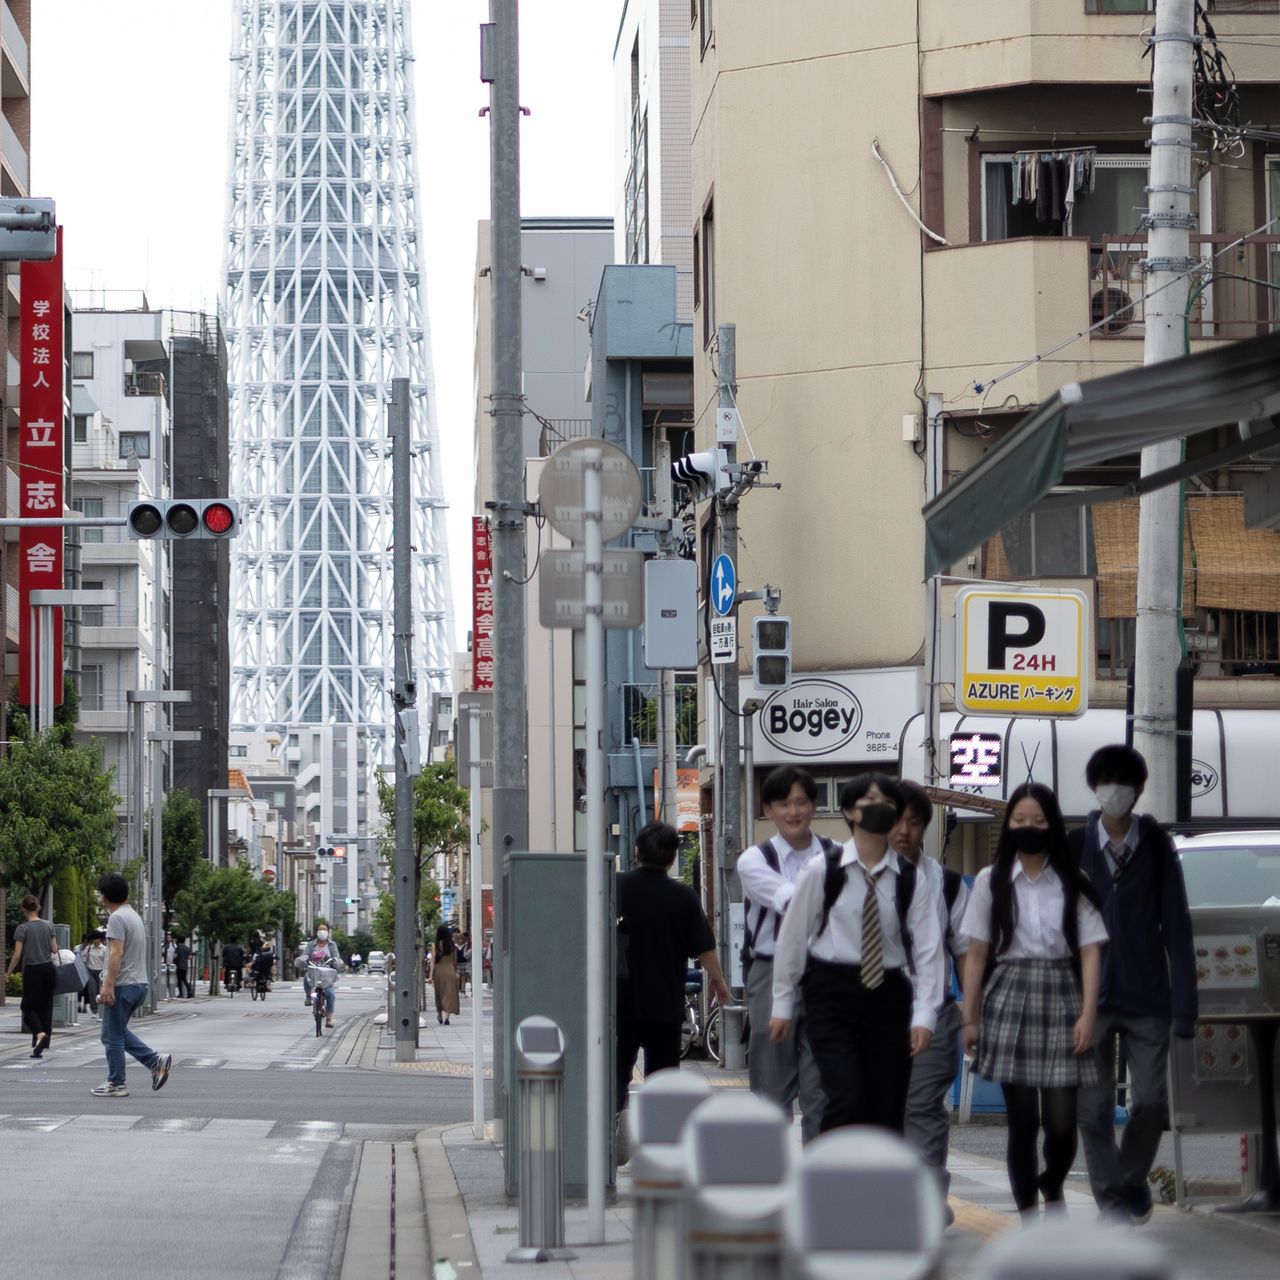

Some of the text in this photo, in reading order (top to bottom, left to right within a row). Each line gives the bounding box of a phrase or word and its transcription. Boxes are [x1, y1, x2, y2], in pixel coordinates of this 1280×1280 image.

[26, 300, 56, 573] 学校法人 立志舎
[988, 601, 1046, 670] P
[1013, 653, 1056, 671] 24H
[968, 683, 1019, 700] AZURE
[793, 698, 838, 708] Hair Salon
[770, 705, 855, 737] Bogey
[866, 731, 890, 739] Phone
[866, 743, 900, 752] 3625-4
[949, 734, 1001, 785] 空
